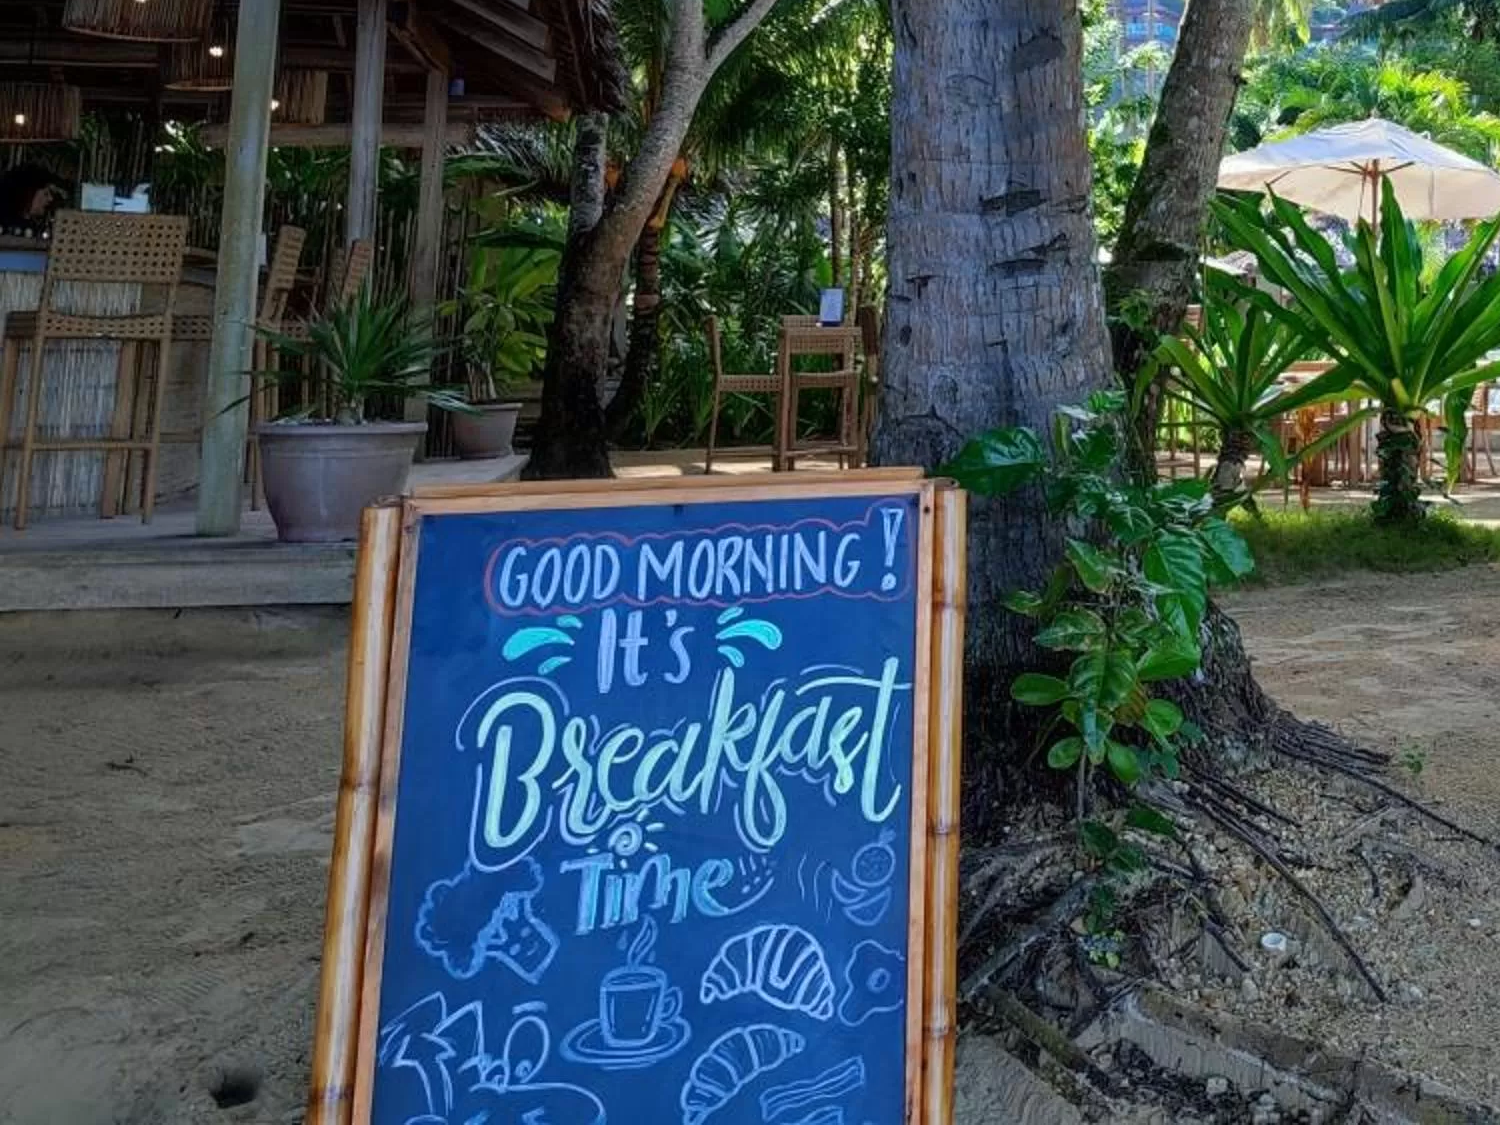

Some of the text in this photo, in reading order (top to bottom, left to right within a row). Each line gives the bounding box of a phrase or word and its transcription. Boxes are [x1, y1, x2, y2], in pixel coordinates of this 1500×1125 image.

[499, 543, 621, 609] GOOD
[598, 607, 696, 694] It's
[476, 656, 913, 849] Breakfast
